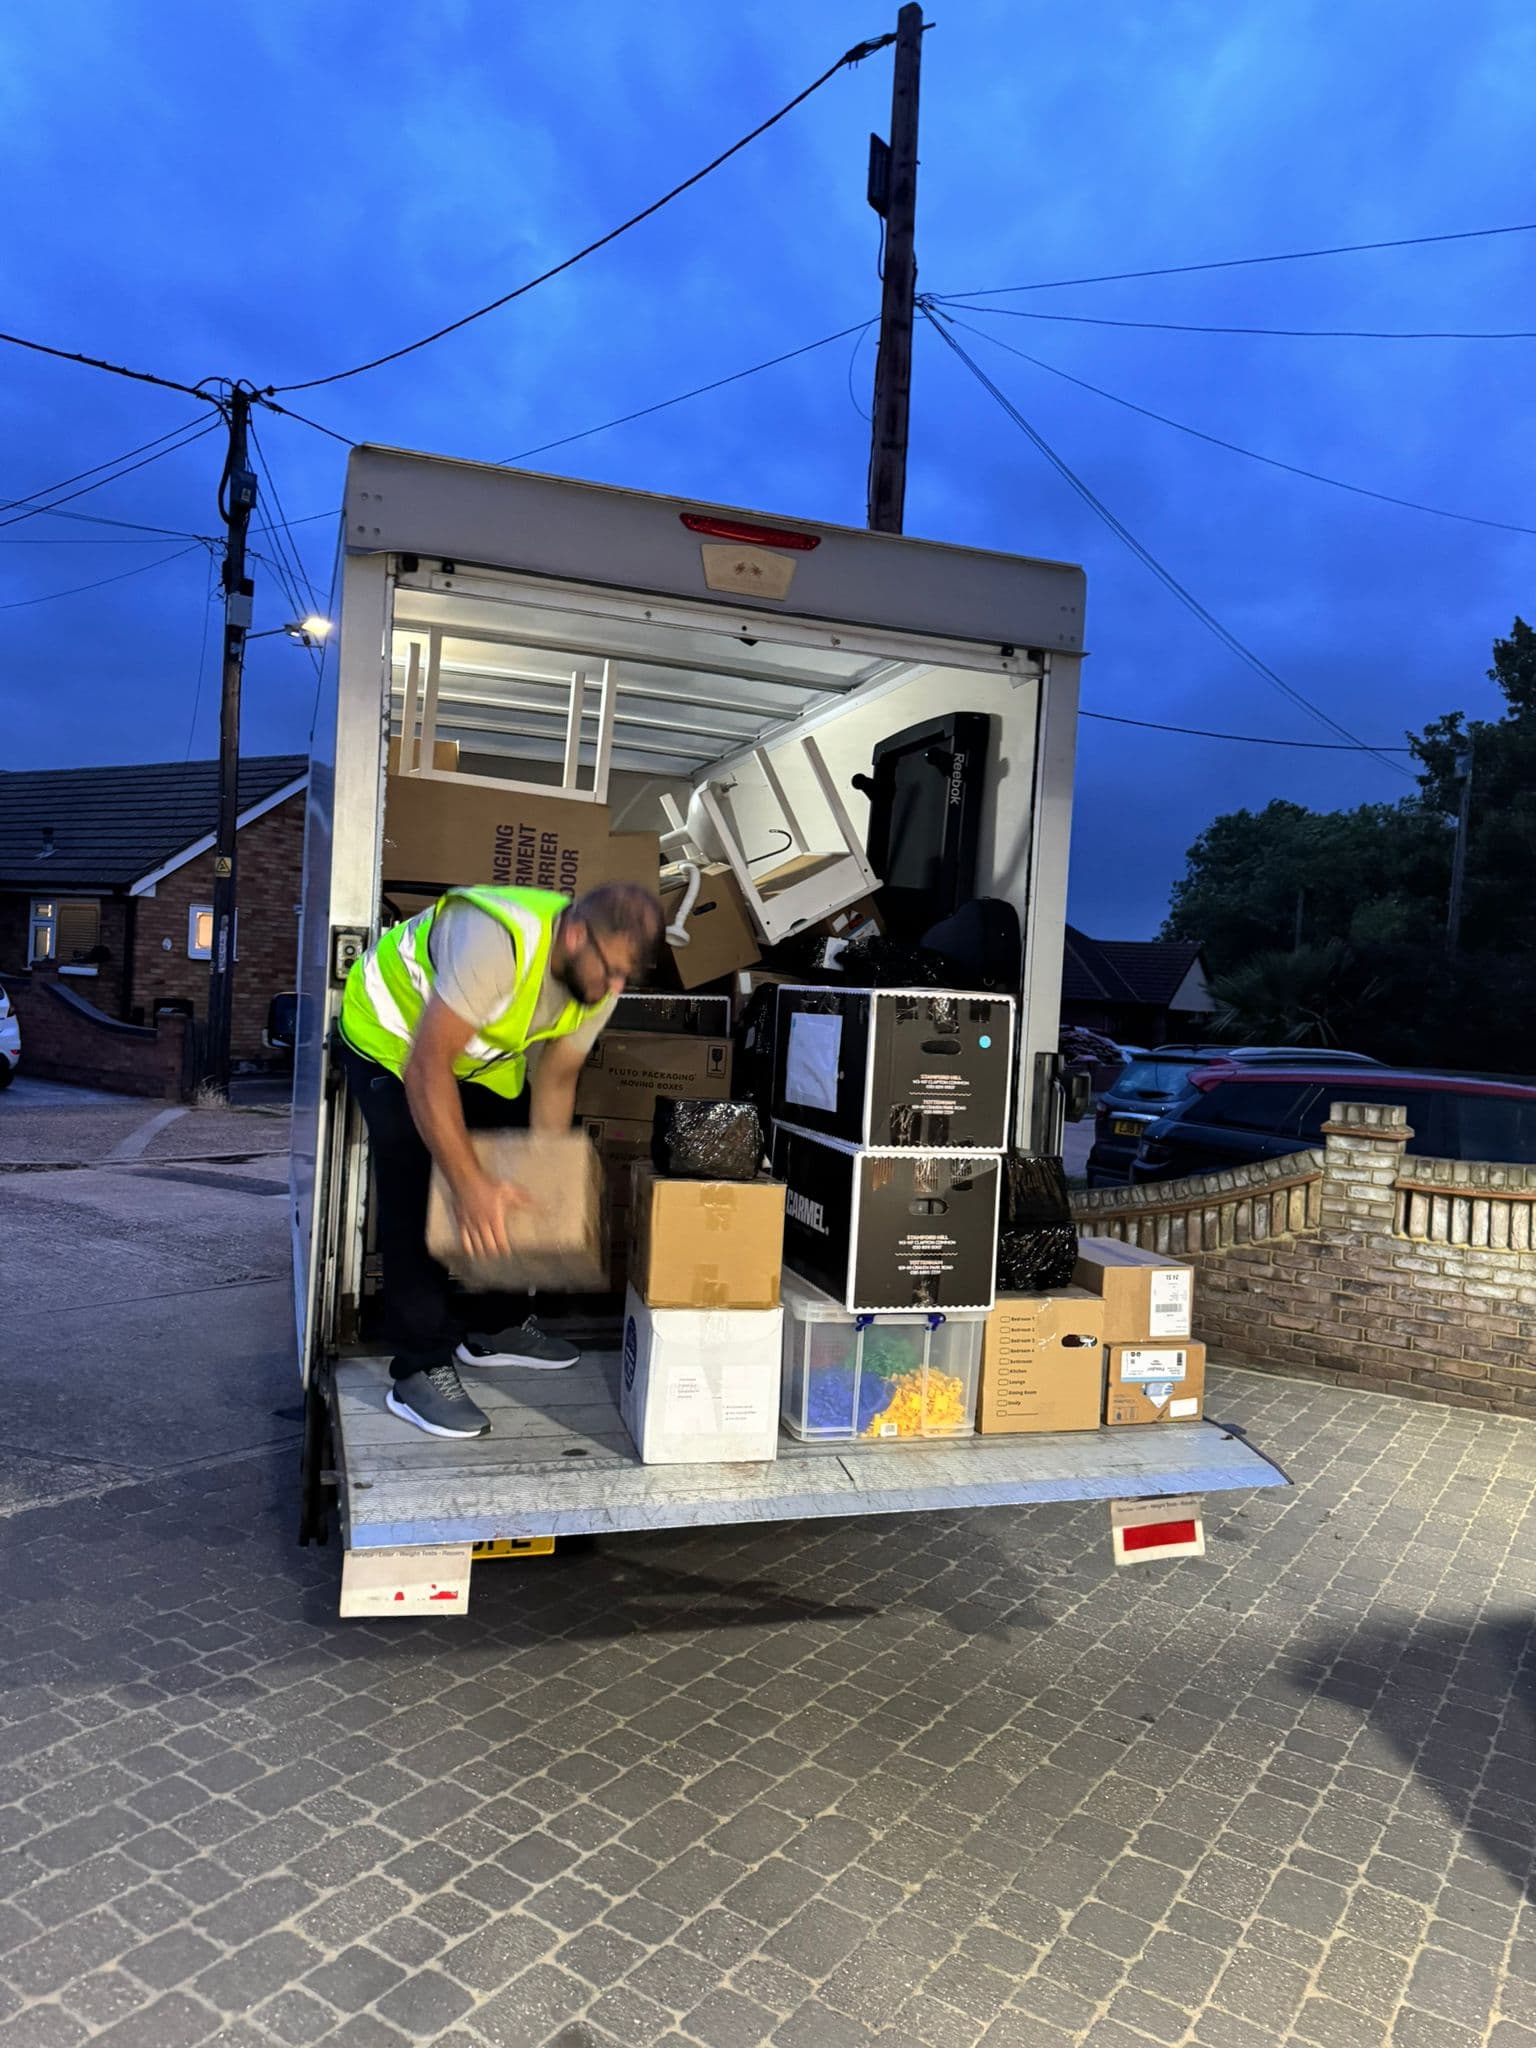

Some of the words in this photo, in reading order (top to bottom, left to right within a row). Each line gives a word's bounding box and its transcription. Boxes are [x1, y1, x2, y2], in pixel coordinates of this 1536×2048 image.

[950, 753, 965, 805] Reebok
[493, 824, 514, 886] NGING
[516, 823, 537, 887] RMENT
[537, 832, 559, 891] RRIER
[608, 1067, 639, 1077] PLUTO
[621, 1080, 655, 1088] MOVING
[657, 1082, 684, 1091] BOXES
